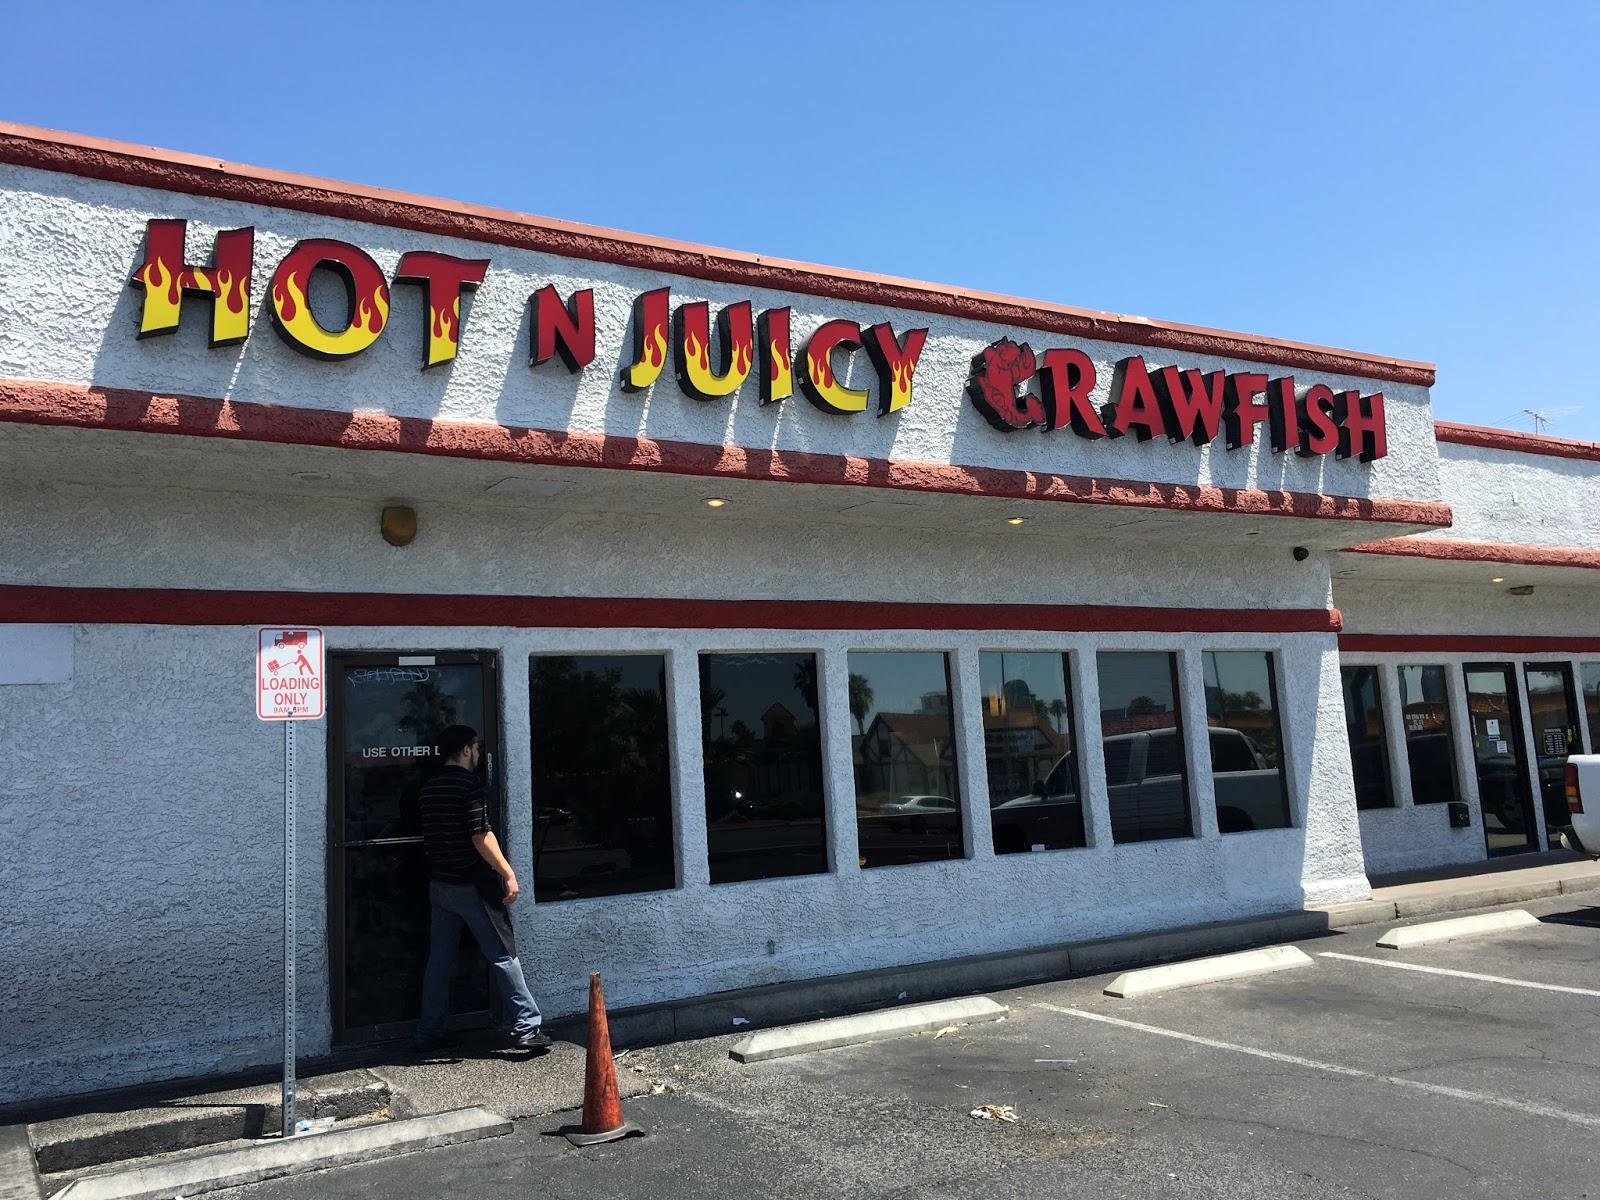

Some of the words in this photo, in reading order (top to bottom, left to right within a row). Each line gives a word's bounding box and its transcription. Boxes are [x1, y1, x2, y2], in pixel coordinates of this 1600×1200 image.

[130, 218, 491, 371] HOT
[529, 283, 595, 374] N
[621, 286, 929, 418] JUICY
[966, 336, 1388, 463] CRAWFISH
[262, 677, 320, 690] LOADING
[274, 692, 308, 705] ONLY
[362, 746, 387, 758] USE
[391, 745, 431, 757] OTHER
